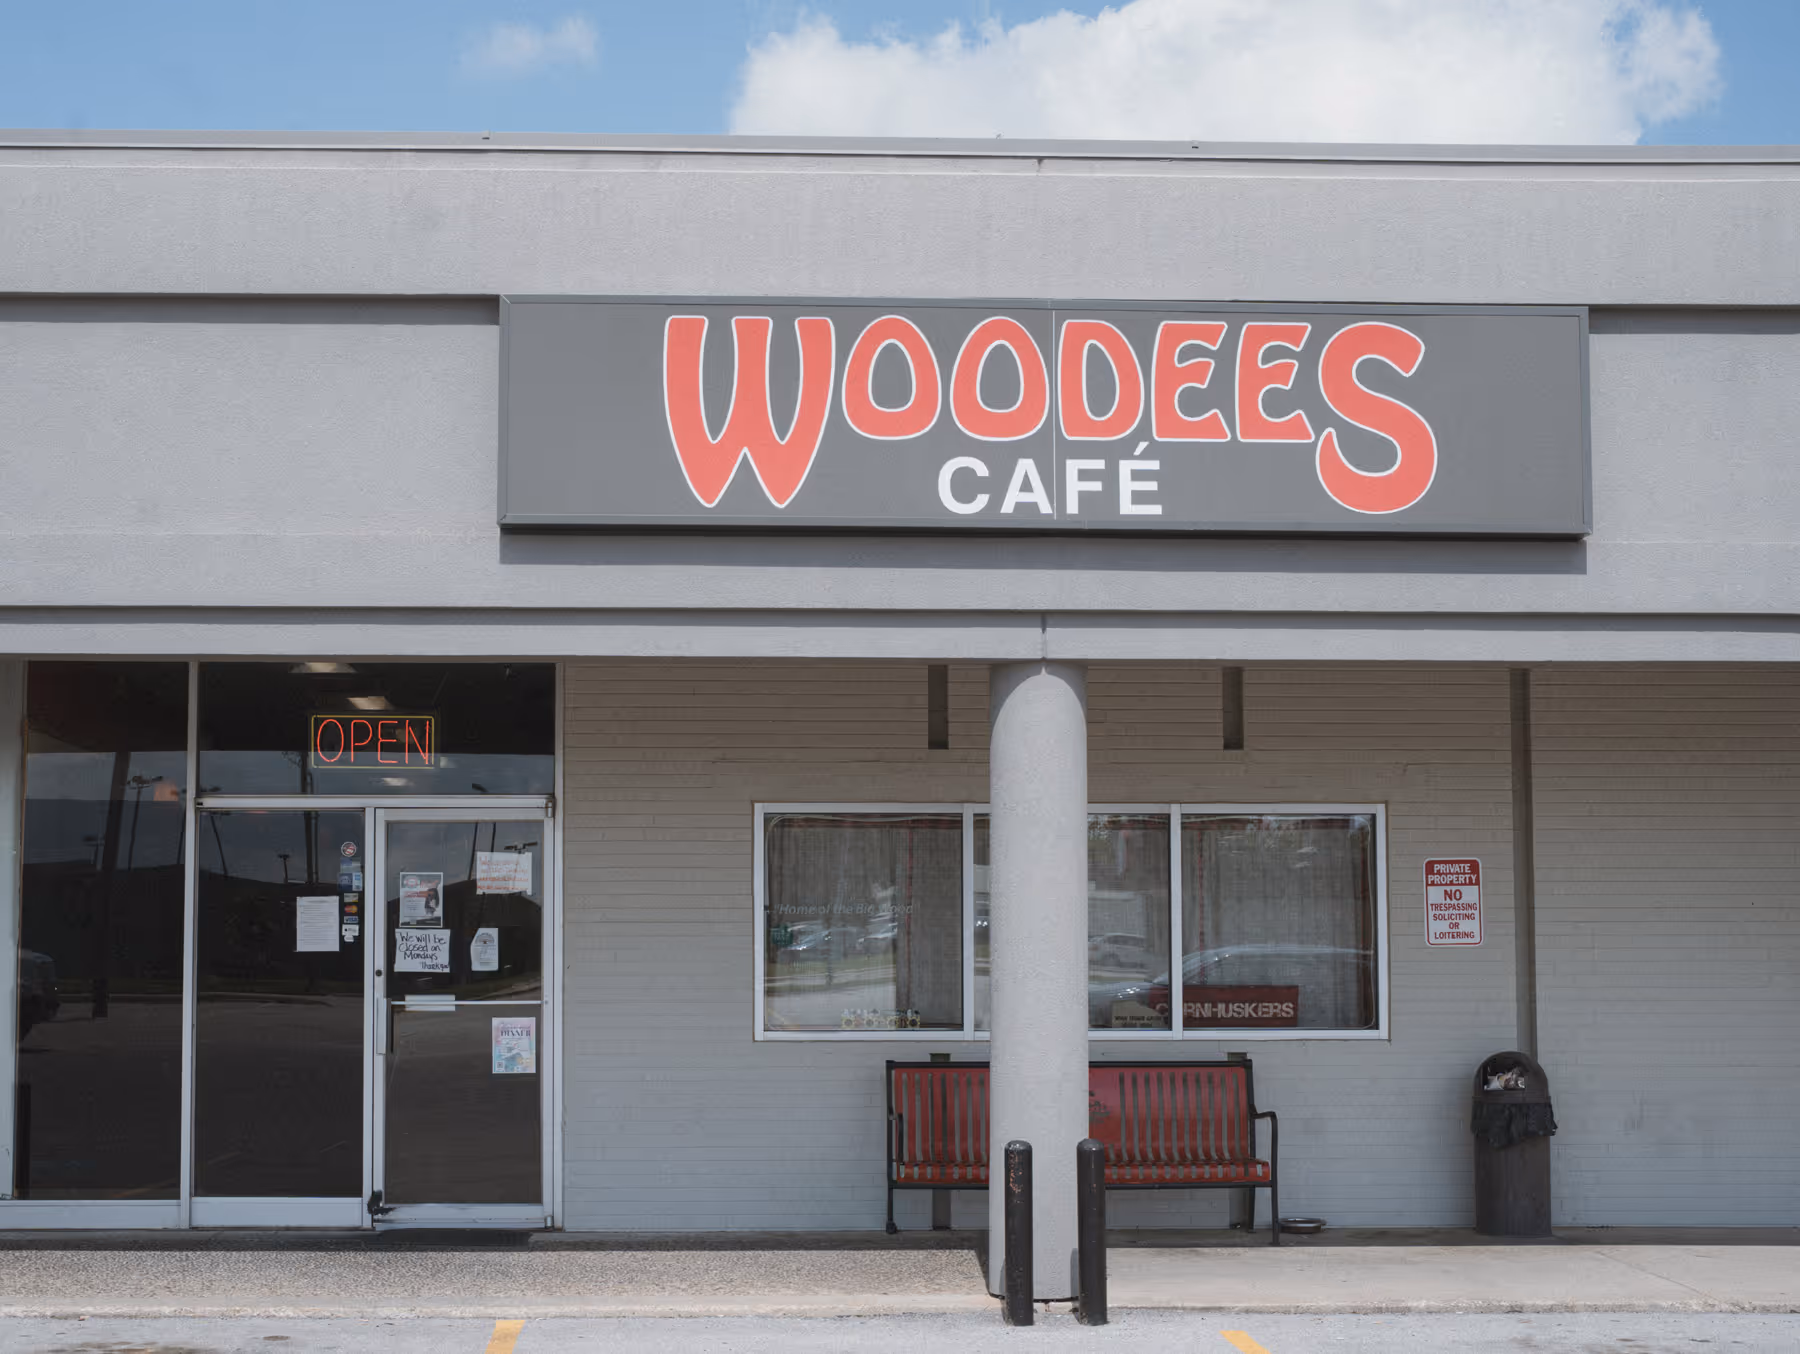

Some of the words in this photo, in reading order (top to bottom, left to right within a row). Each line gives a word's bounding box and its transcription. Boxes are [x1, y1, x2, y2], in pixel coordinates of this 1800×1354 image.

[663, 314, 1438, 515] WOODEES
[938, 441, 1163, 515] CAFÉ
[317, 719, 430, 764] OPEN
[1434, 864, 1471, 873] PRIVATE
[1428, 874, 1477, 884] PROPERTY
[1443, 889, 1463, 901] NO
[1430, 903, 1477, 911] TRESPASSING
[1433, 912, 1475, 921] SOLICITING
[400, 932, 413, 942] We
[416, 933, 430, 943] will
[433, 934, 446, 944] be
[431, 944, 441, 952] on
[404, 951, 438, 963] Mondays
[1155, 1002, 1294, 1018] CRNHUSKERS
